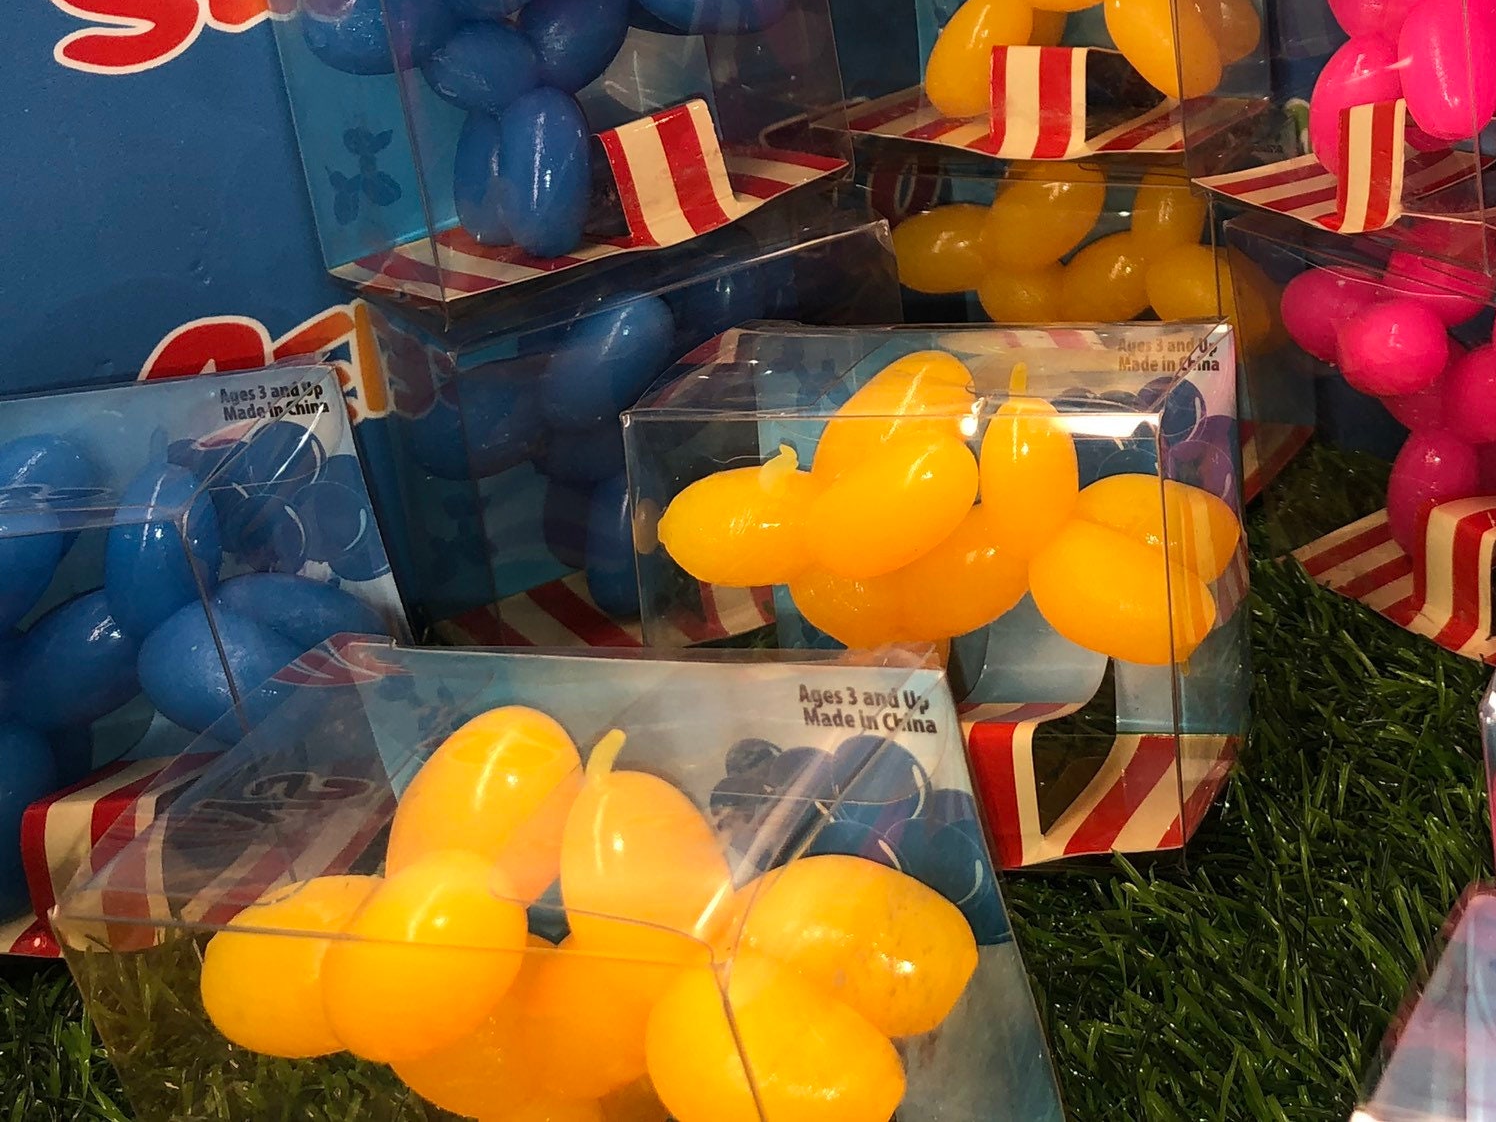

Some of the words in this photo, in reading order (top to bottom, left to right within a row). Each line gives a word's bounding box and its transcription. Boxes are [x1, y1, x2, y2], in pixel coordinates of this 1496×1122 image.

[1117, 338, 1152, 356] Ages
[1155, 338, 1163, 352] 3
[1167, 337, 1195, 353] and
[1119, 356, 1159, 372] Made
[1162, 355, 1176, 372] in
[221, 388, 256, 406] Ages
[258, 385, 267, 400] 3
[270, 381, 299, 398] and
[223, 403, 265, 421] Made
[268, 401, 283, 418] in
[286, 399, 330, 416] China
[799, 683, 844, 708] Ages
[846, 686, 858, 705] 3
[862, 687, 900, 708] and
[803, 707, 855, 728] Made
[858, 709, 879, 730] in
[882, 712, 938, 734] China
